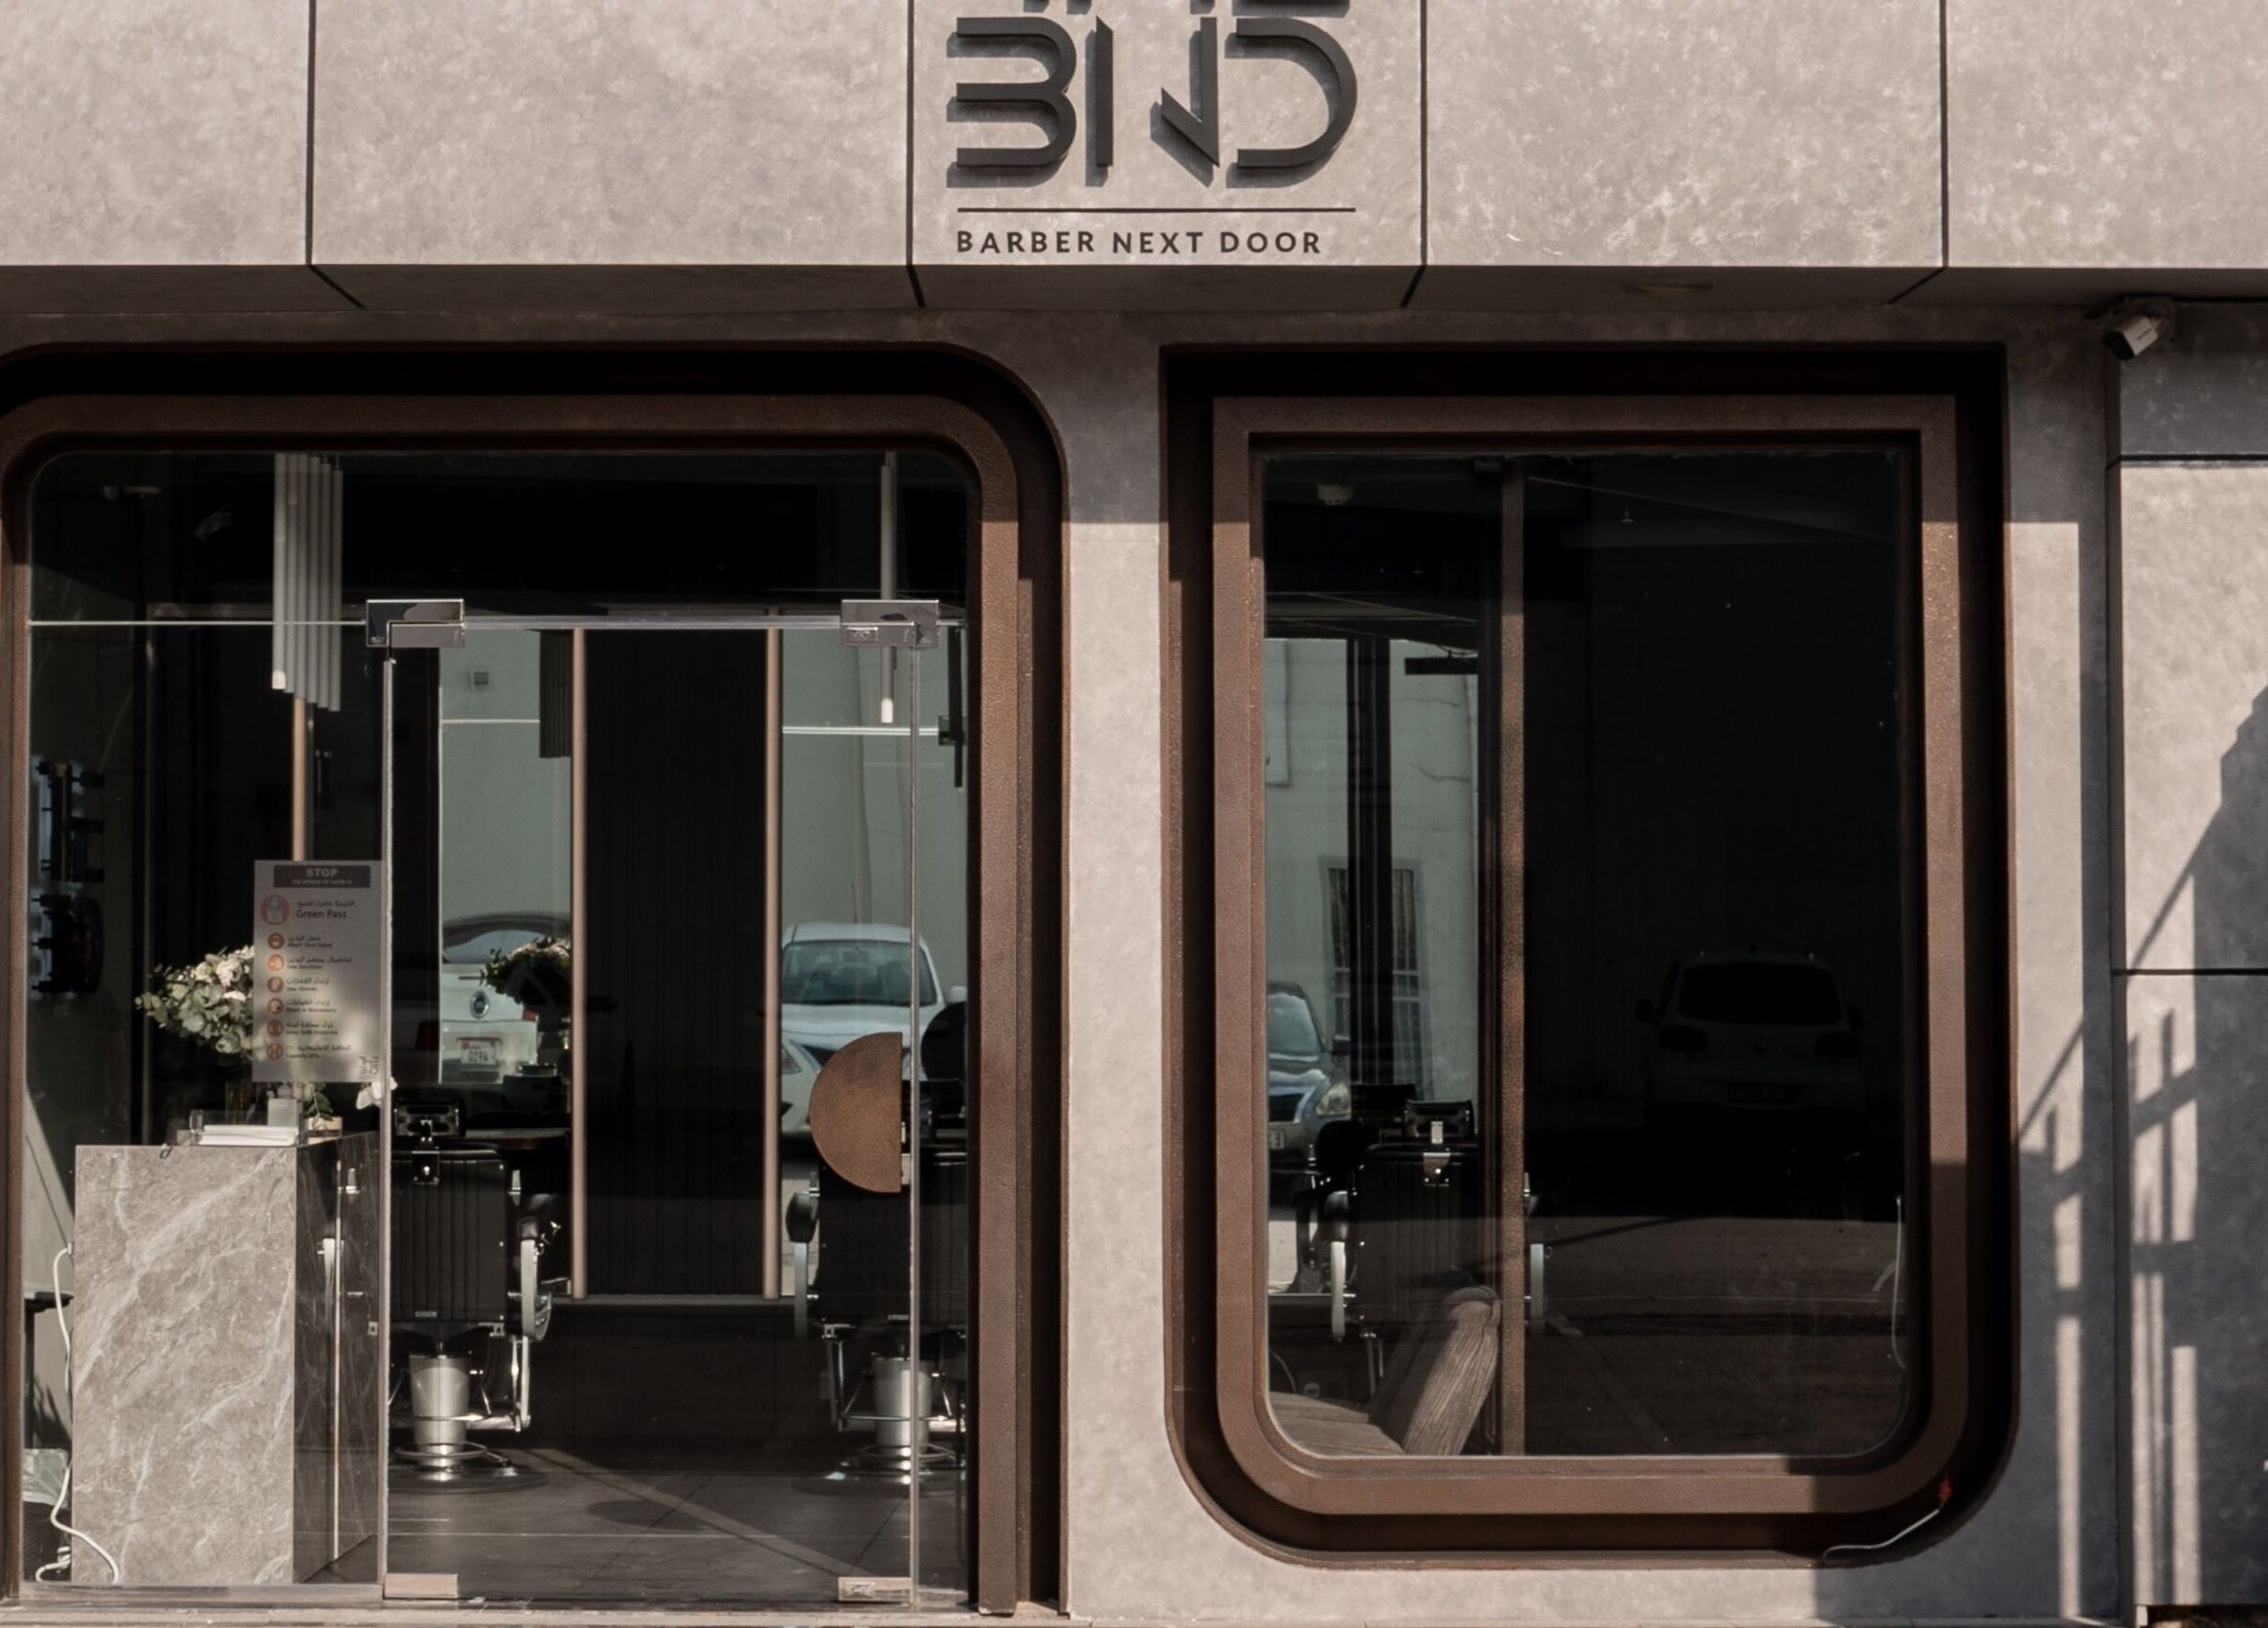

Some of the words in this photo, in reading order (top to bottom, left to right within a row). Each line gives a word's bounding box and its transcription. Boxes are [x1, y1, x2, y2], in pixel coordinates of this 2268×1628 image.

[957, 230, 1095, 254] BARBER
[1112, 231, 1203, 254] NEXT
[1220, 231, 1321, 254] DOOR
[305, 868, 338, 877] STOP
[296, 909, 324, 919] Green
[327, 909, 348, 919] Pass
